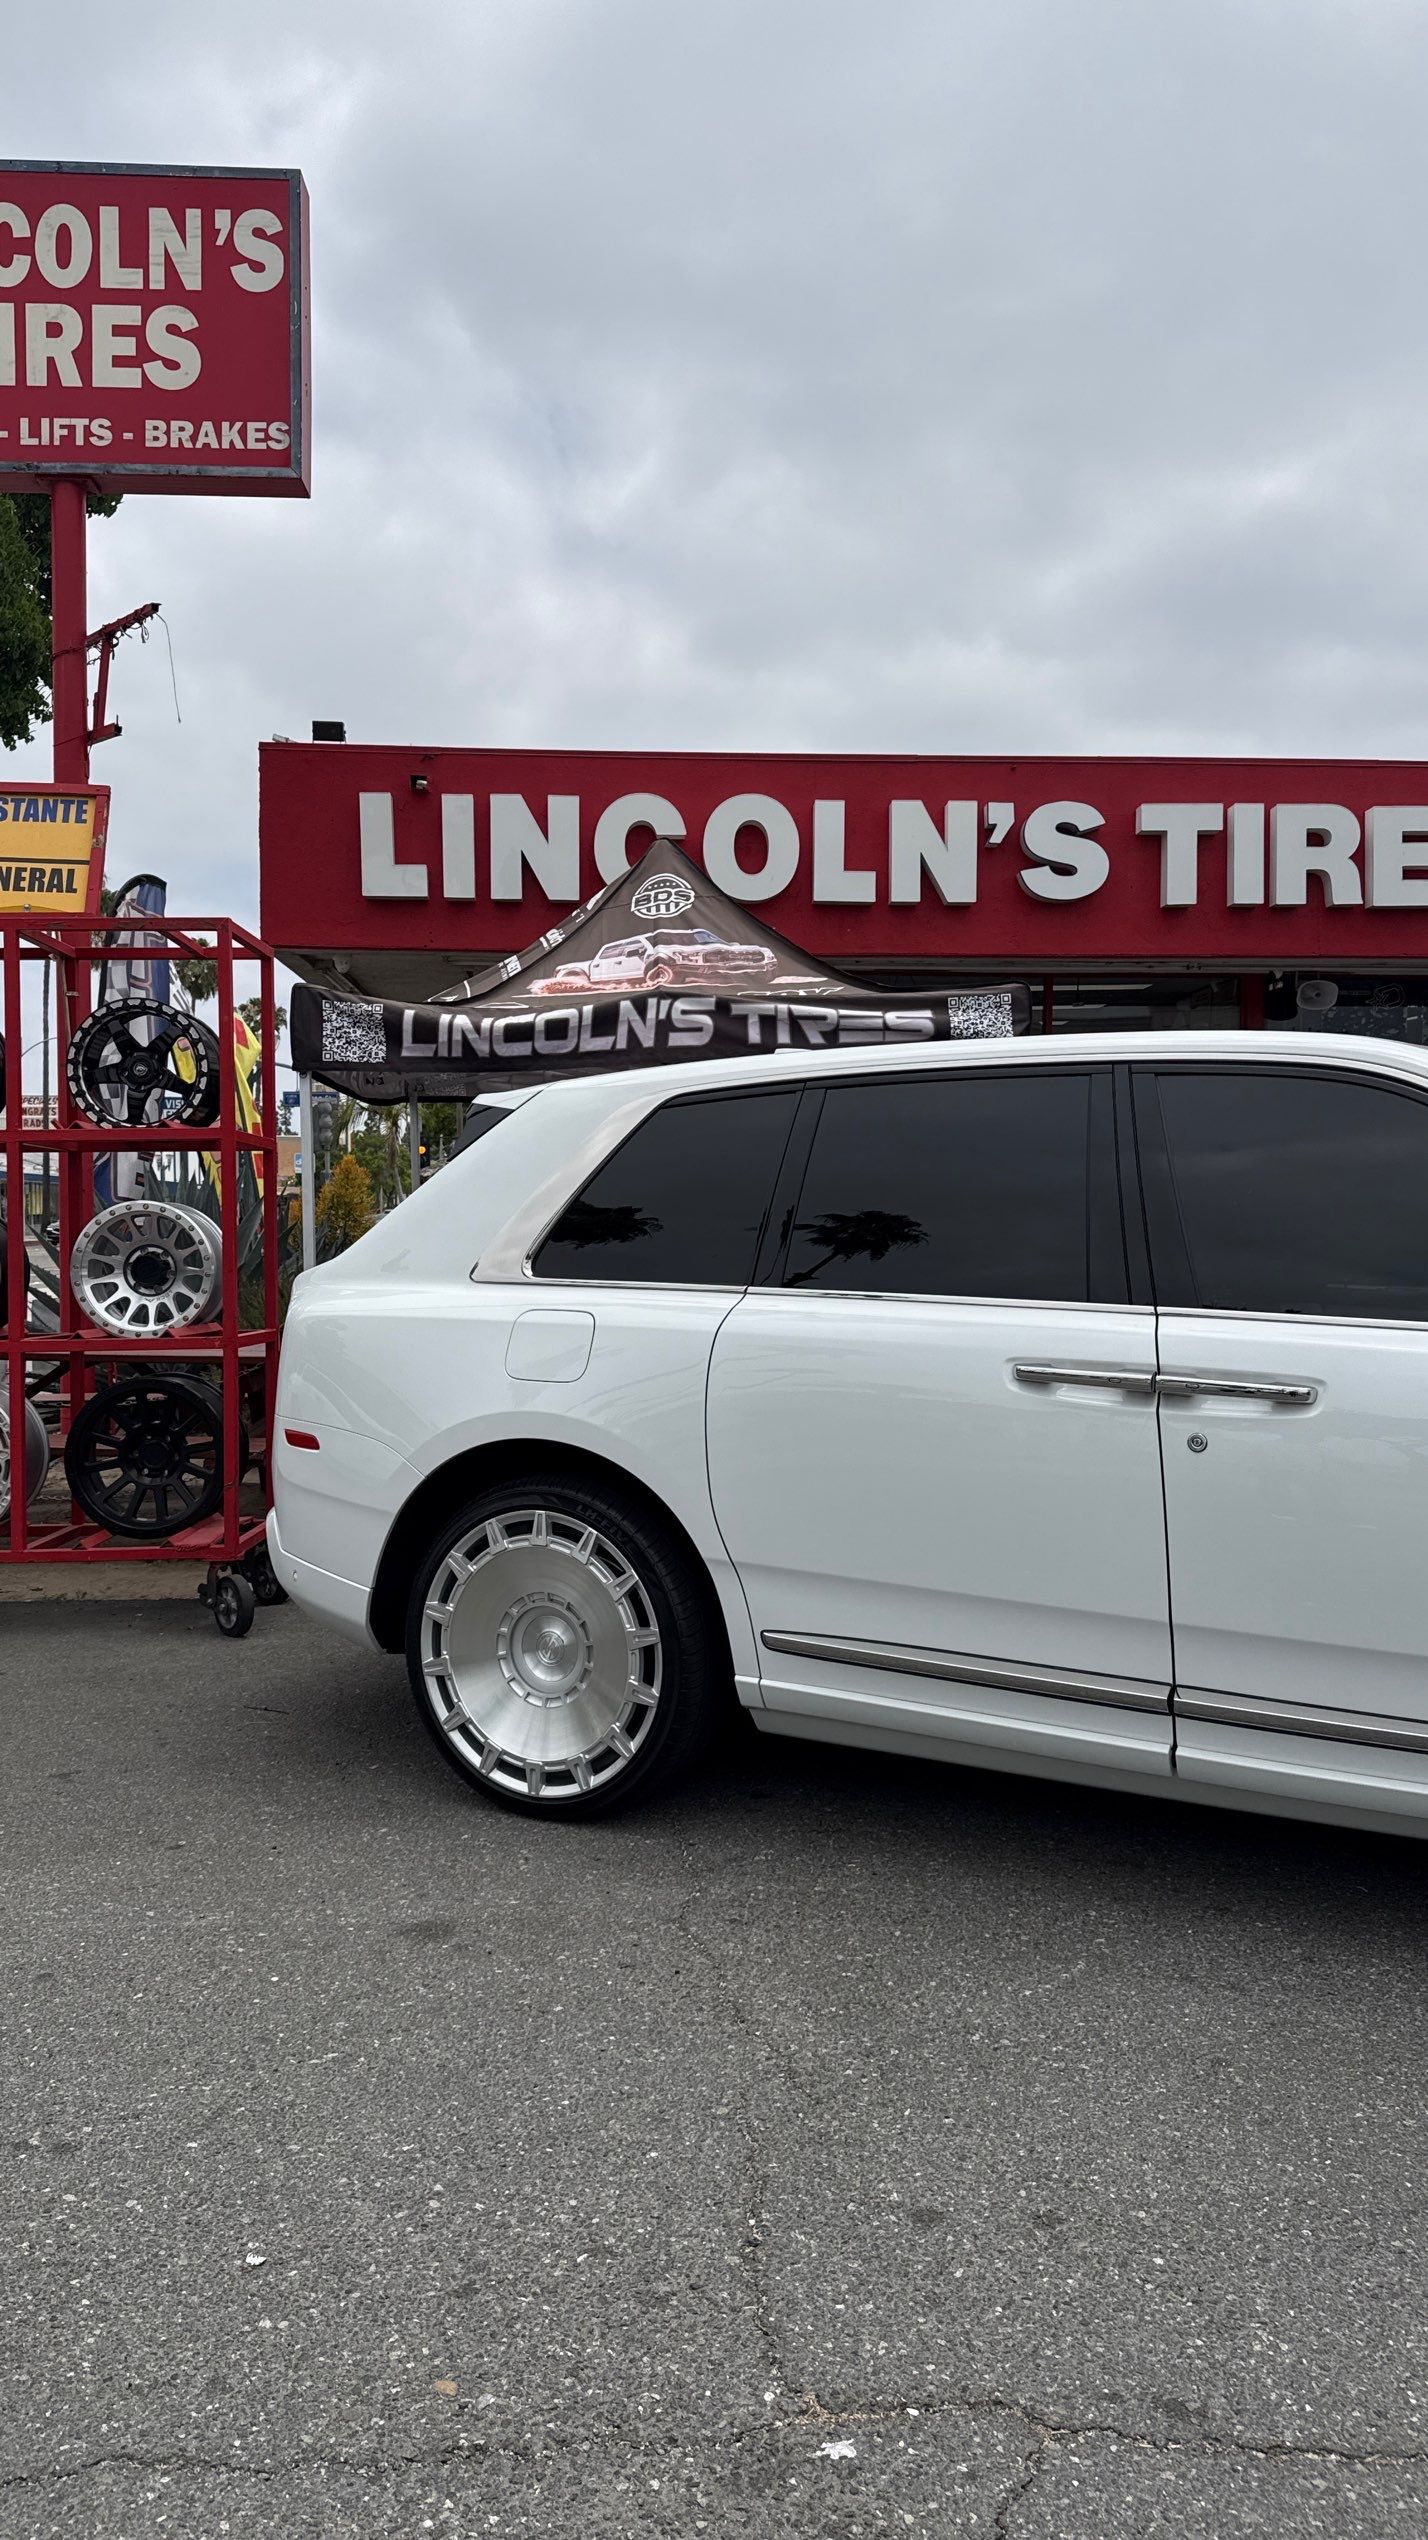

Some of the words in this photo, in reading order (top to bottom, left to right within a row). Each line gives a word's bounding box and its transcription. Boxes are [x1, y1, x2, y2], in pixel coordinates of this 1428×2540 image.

[0, 302, 202, 391] IRES
[19, 417, 113, 447] LIFTS
[144, 419, 290, 450] BRAKES
[0, 796, 89, 824] STANTE
[359, 791, 1110, 905] LINCOLN'S
[1136, 802, 1428, 908] TIRE
[0, 866, 78, 894] NERAL
[631, 888, 695, 912] BDS
[400, 995, 717, 1060] LINCOLN'S
[729, 1002, 935, 1046] TIRES
